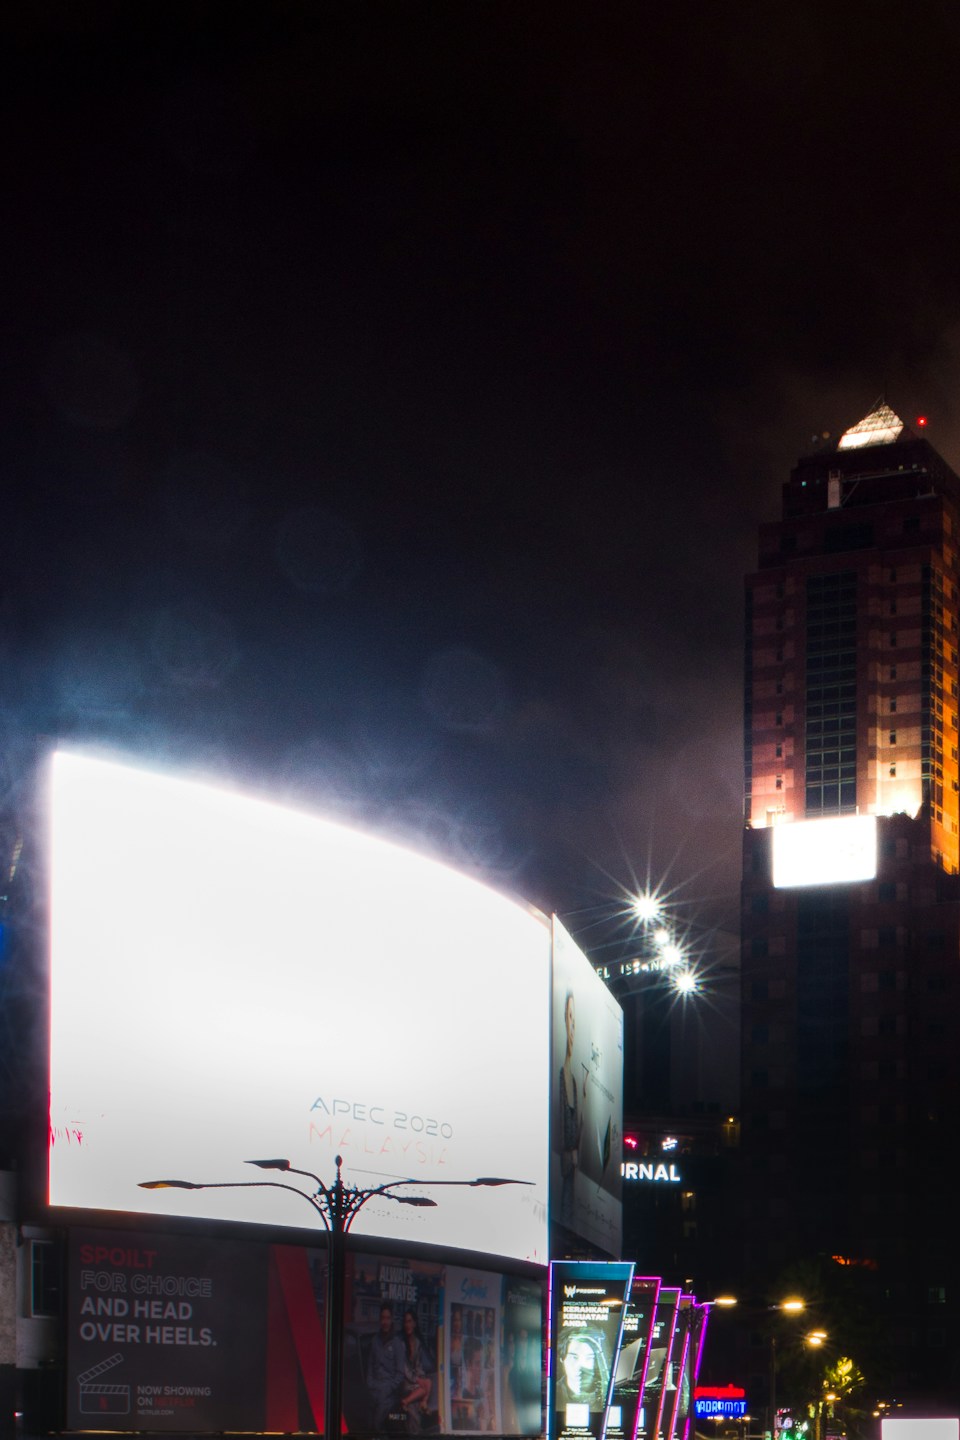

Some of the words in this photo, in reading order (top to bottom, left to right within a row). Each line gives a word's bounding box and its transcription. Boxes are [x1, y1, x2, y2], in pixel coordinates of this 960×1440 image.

[309, 1096, 385, 1125] APEC
[393, 1111, 454, 1140] 2020
[80, 1246, 157, 1269] SPOILT
[81, 1270, 127, 1293] FOR
[131, 1274, 212, 1298] CHOICE
[80, 1297, 129, 1317] AND
[134, 1300, 193, 1321] HEAD
[80, 1322, 140, 1343] OVER
[145, 1326, 218, 1347] HEELS.
[137, 1385, 162, 1397] NOW
[163, 1385, 211, 1397] SHOWING
[137, 1396, 153, 1407] ON
